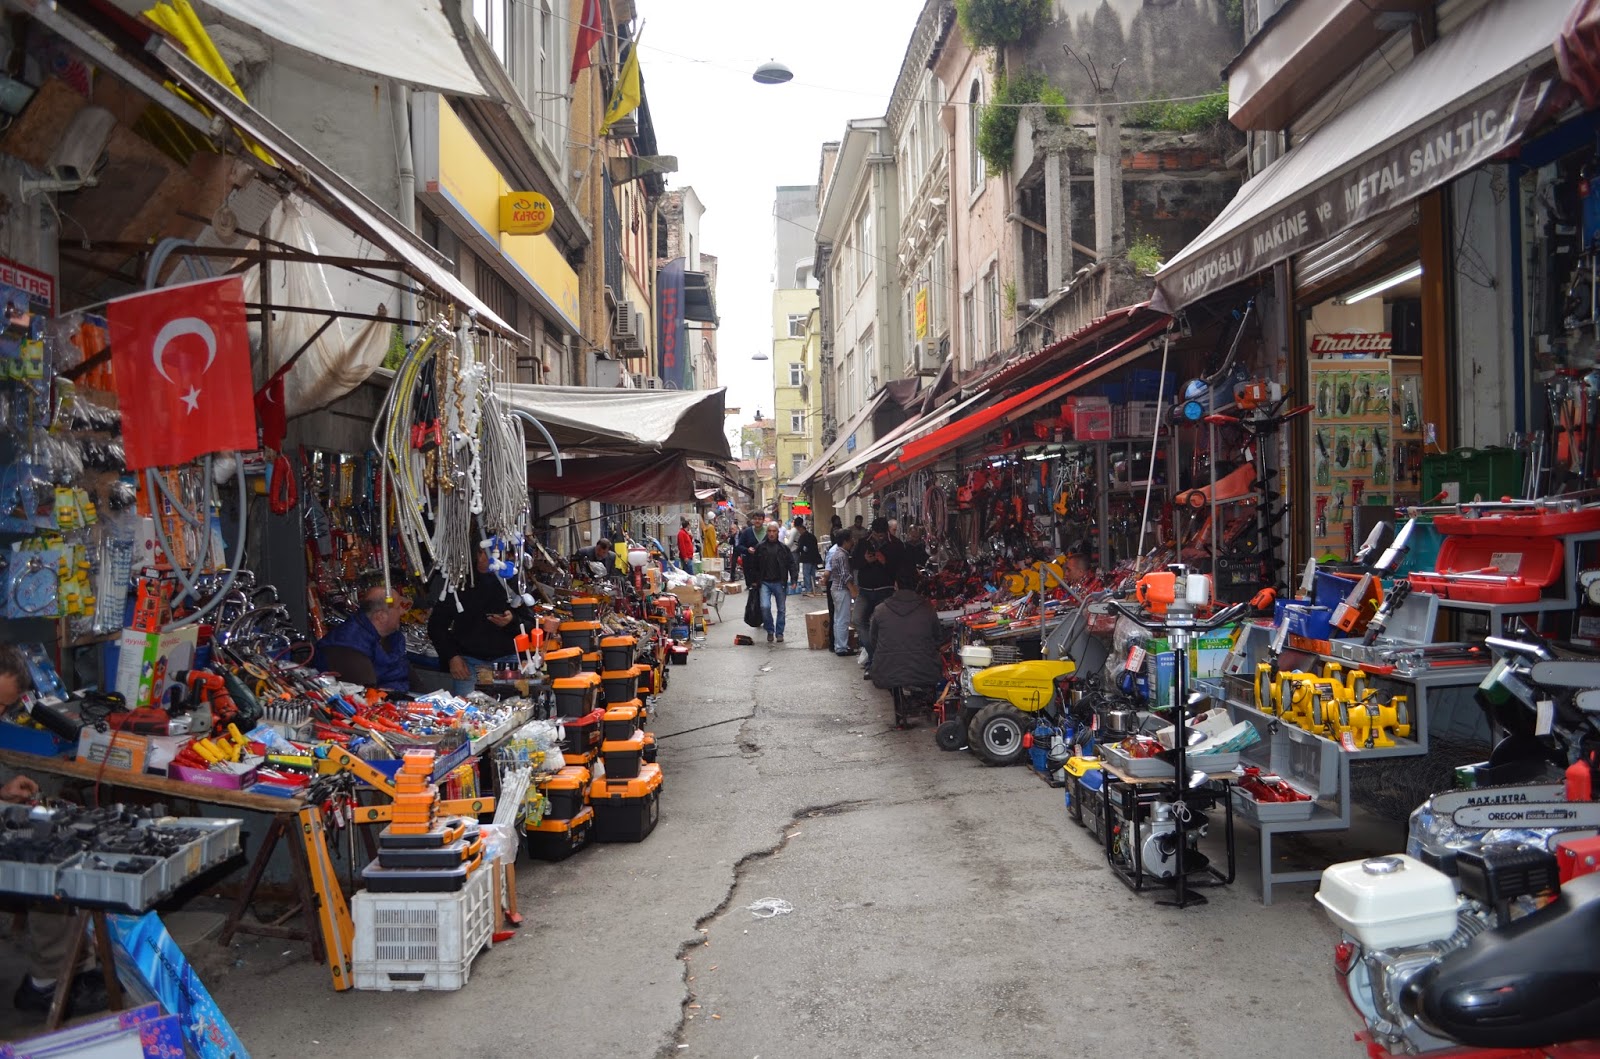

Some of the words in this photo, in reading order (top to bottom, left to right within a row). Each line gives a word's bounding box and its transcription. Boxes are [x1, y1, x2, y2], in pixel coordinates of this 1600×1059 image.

[1183, 248, 1242, 294] KURTOĞLU
[1253, 210, 1309, 257] MAKİNE
[1316, 201, 1332, 223] ve
[1344, 161, 1405, 213] METAL
[662, 287, 677, 368] BOSCH
[1487, 812, 1524, 821] OREGON
[1568, 810, 1577, 819] 91
